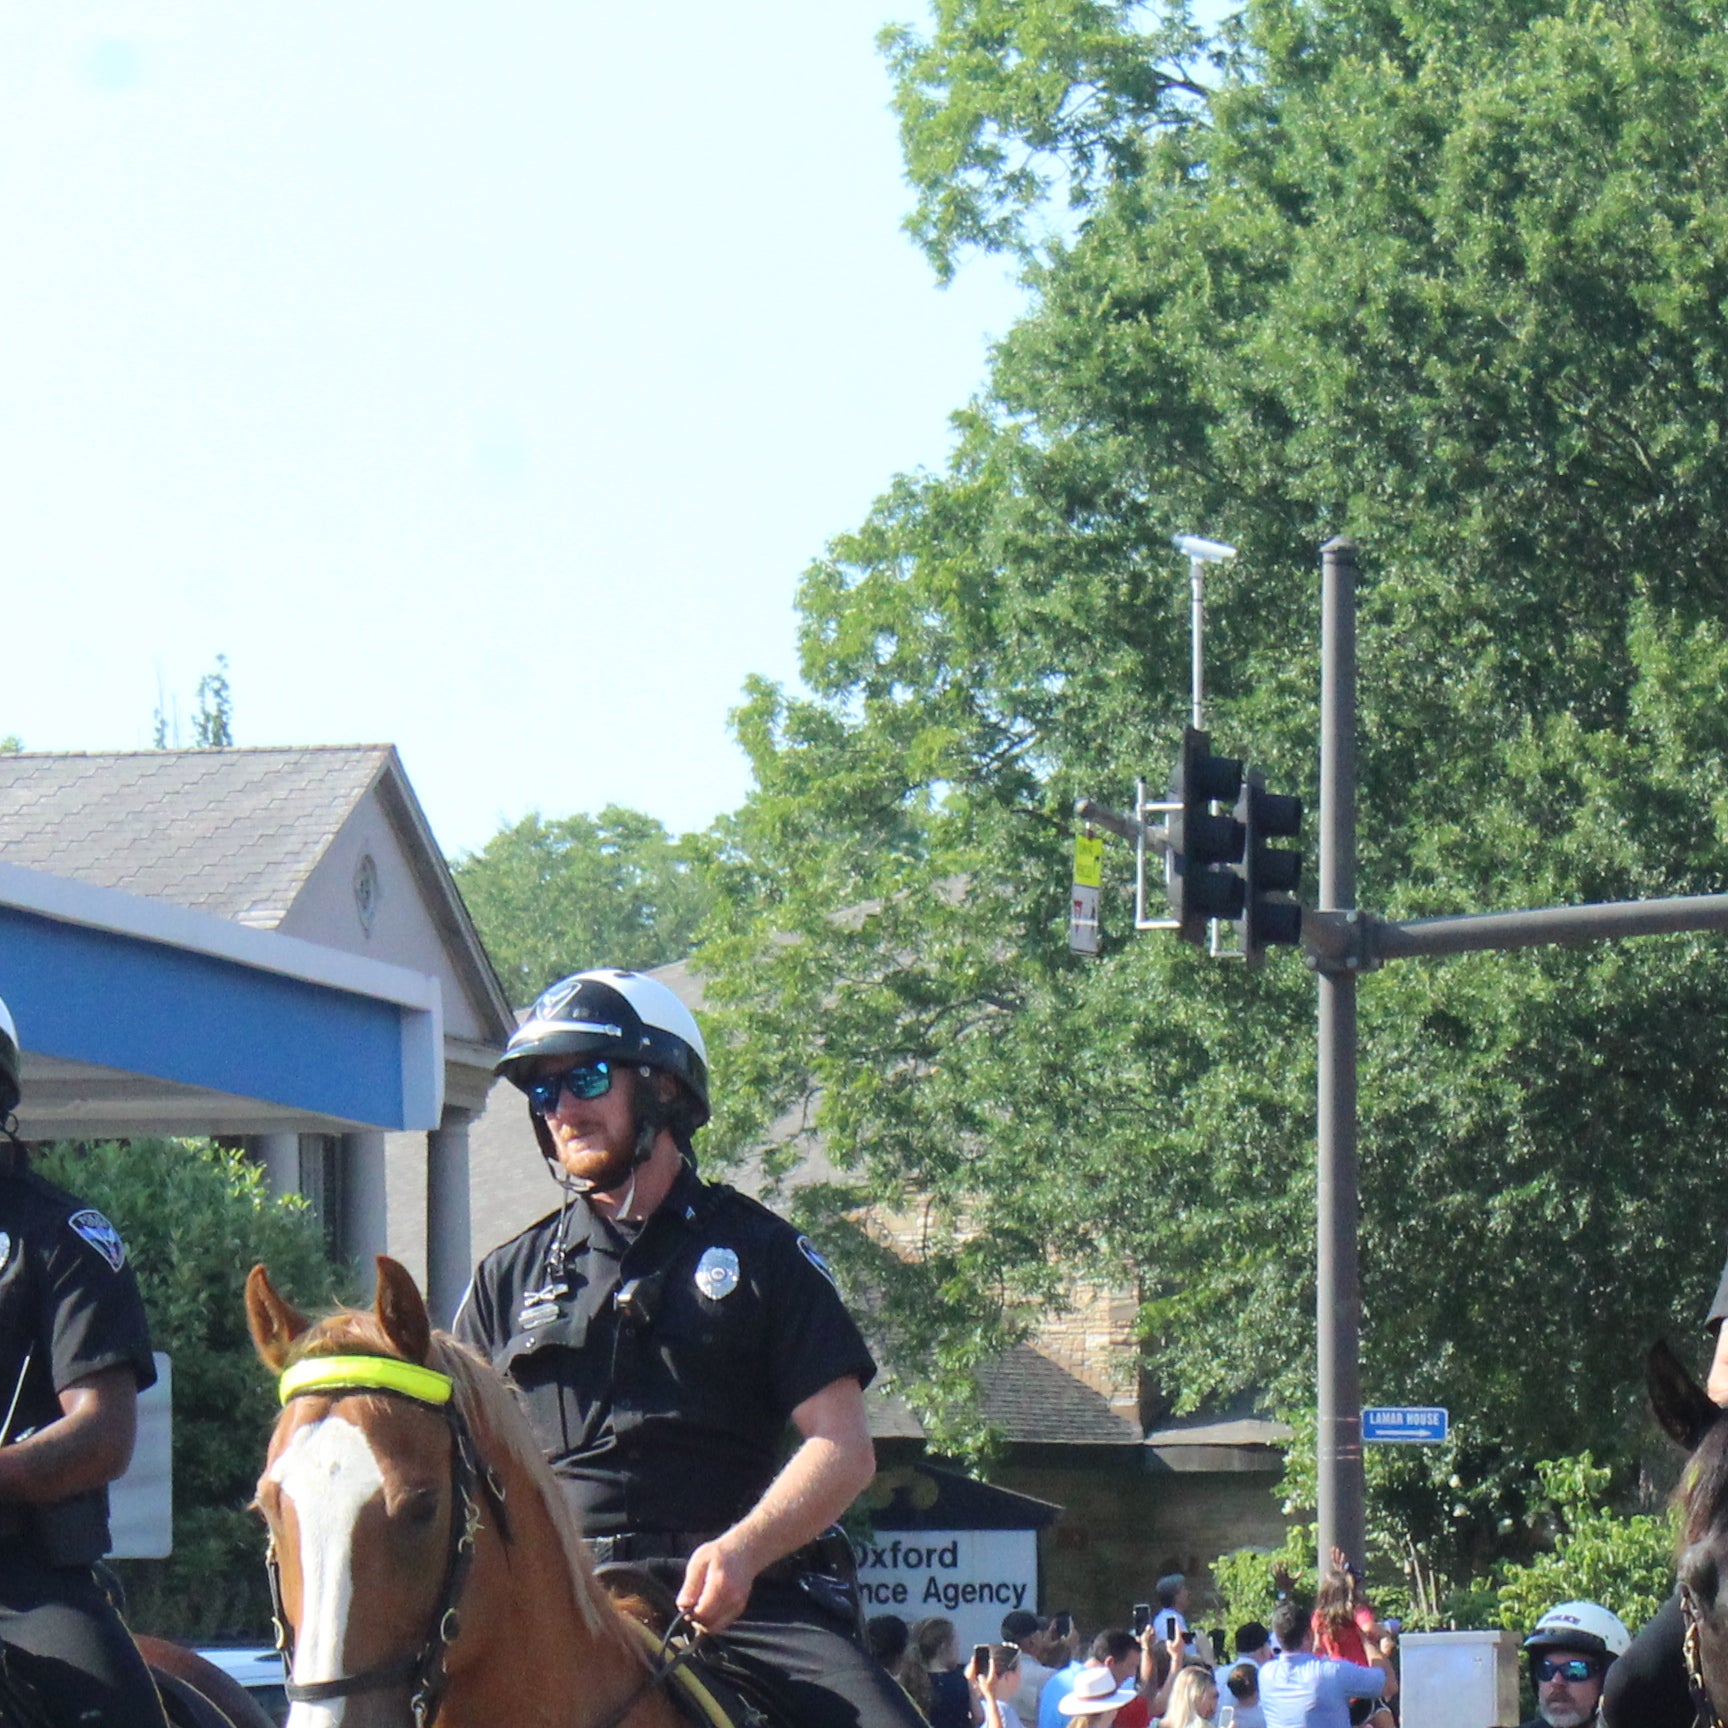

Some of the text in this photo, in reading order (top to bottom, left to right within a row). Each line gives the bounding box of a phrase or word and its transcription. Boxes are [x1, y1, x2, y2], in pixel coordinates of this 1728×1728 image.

[1369, 1411, 1441, 1426] LAMAR HOUSE
[923, 1575, 1028, 1611] Agency
